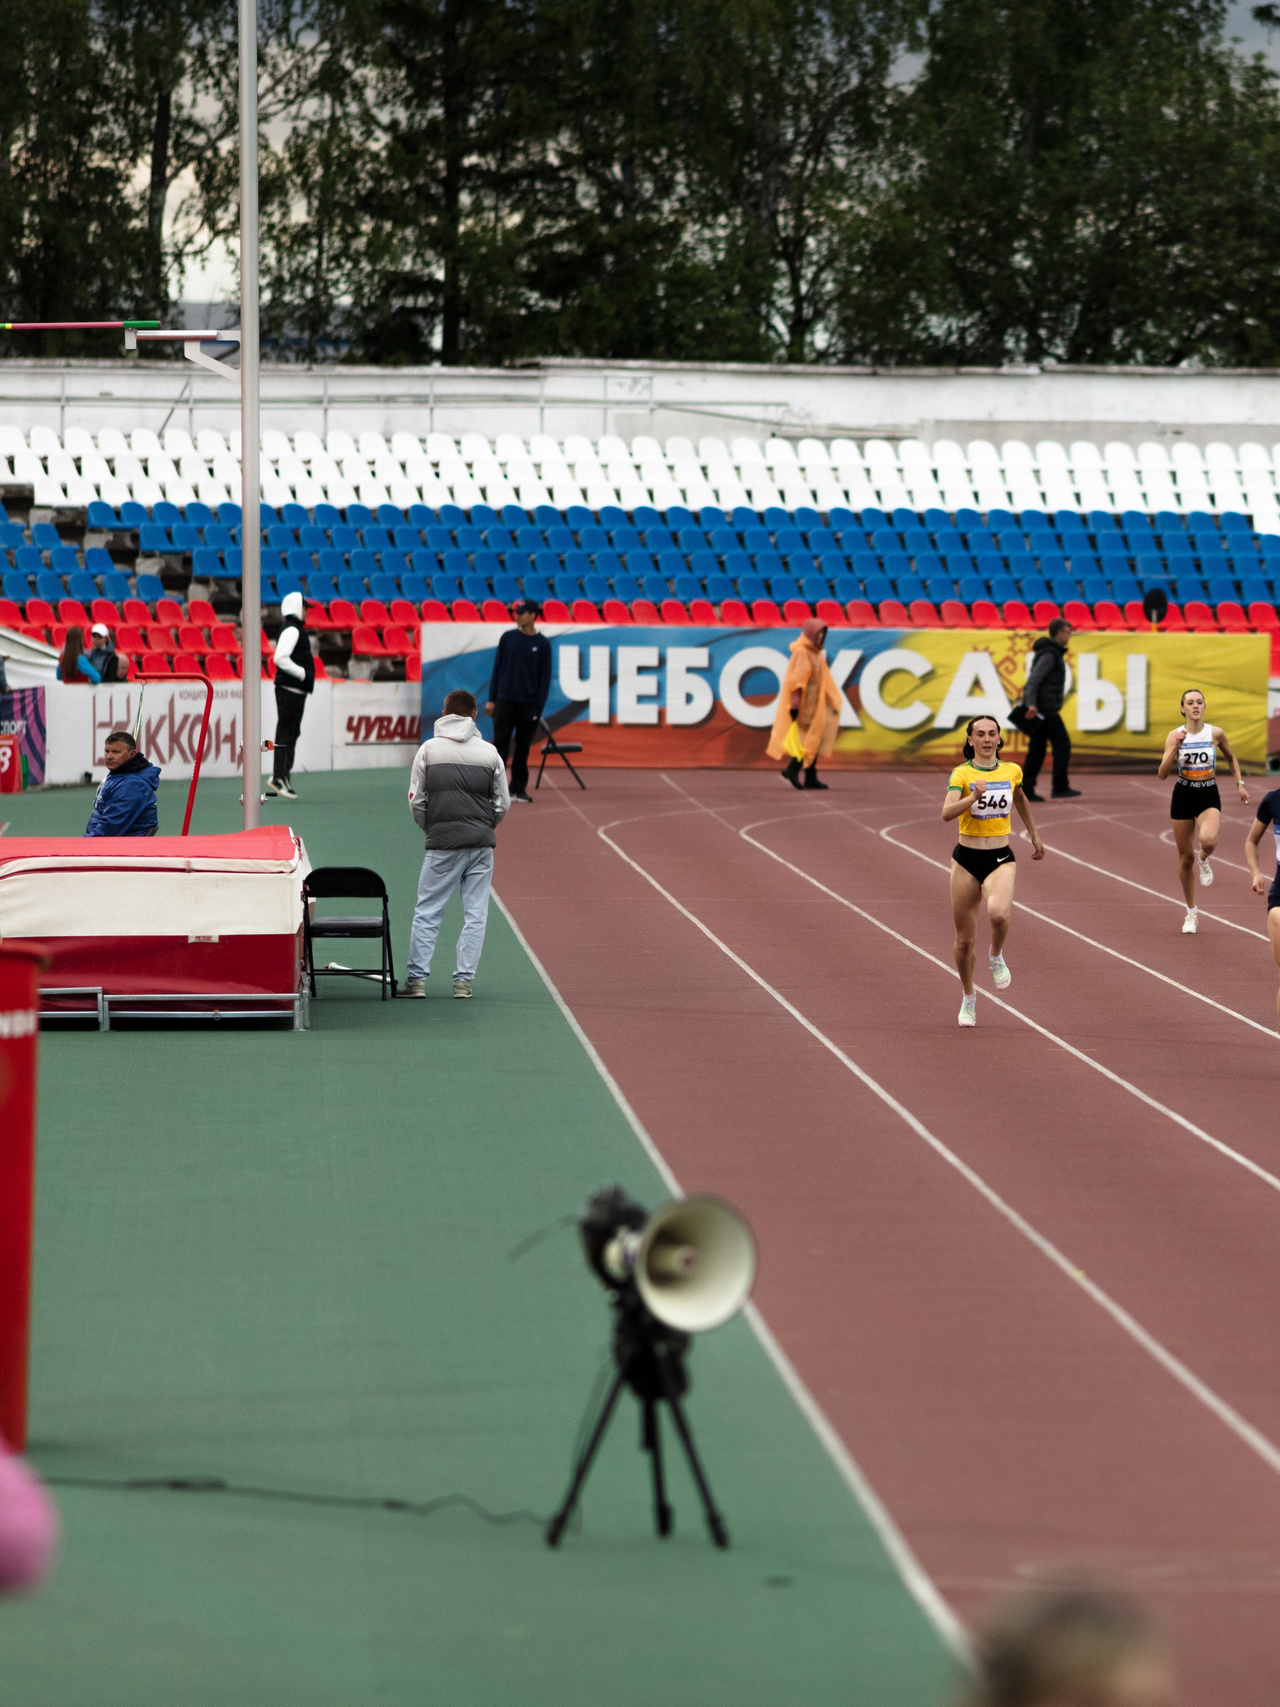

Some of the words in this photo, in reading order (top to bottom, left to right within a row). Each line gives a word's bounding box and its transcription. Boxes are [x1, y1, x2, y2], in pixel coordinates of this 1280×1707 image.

[559, 645, 1147, 730] ЧЕБОКСАЫ
[1184, 752, 1209, 764] 270
[977, 795, 1008, 810] 546
